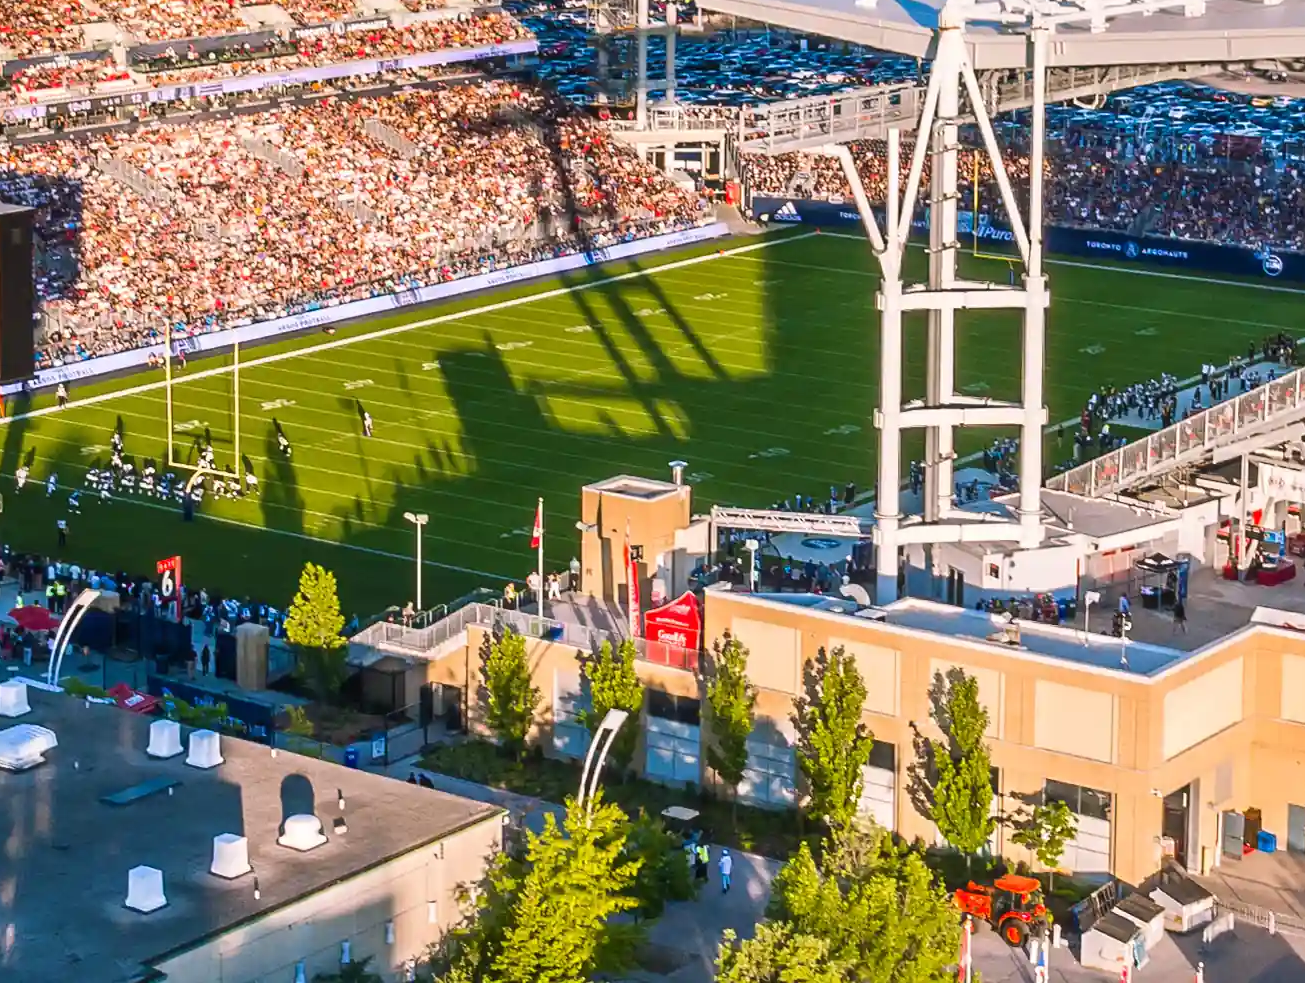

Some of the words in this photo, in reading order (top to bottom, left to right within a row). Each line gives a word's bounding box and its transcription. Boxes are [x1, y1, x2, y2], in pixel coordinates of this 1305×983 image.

[1086, 240, 1122, 252] TORONTO
[1141, 248, 1189, 260] ARGONAUTS
[161, 569, 174, 597] 6
